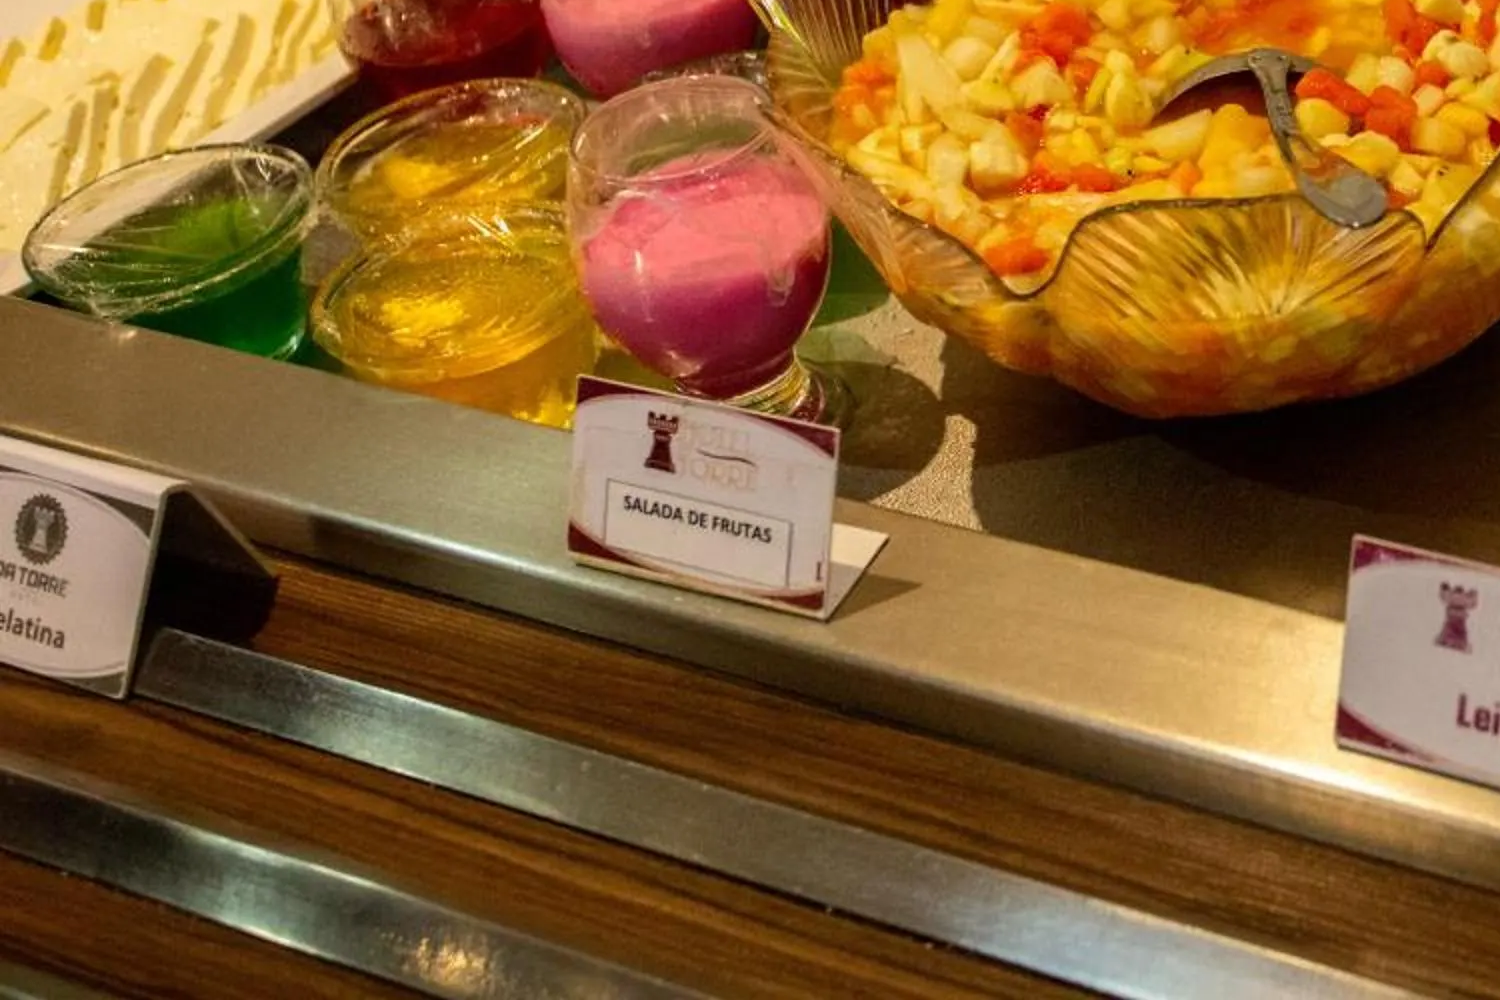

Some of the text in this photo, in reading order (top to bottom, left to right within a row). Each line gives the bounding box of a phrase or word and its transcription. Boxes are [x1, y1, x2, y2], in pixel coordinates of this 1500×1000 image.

[623, 495, 772, 544] SALADA DE FRUTAS
[20, 566, 70, 597] TORRE
